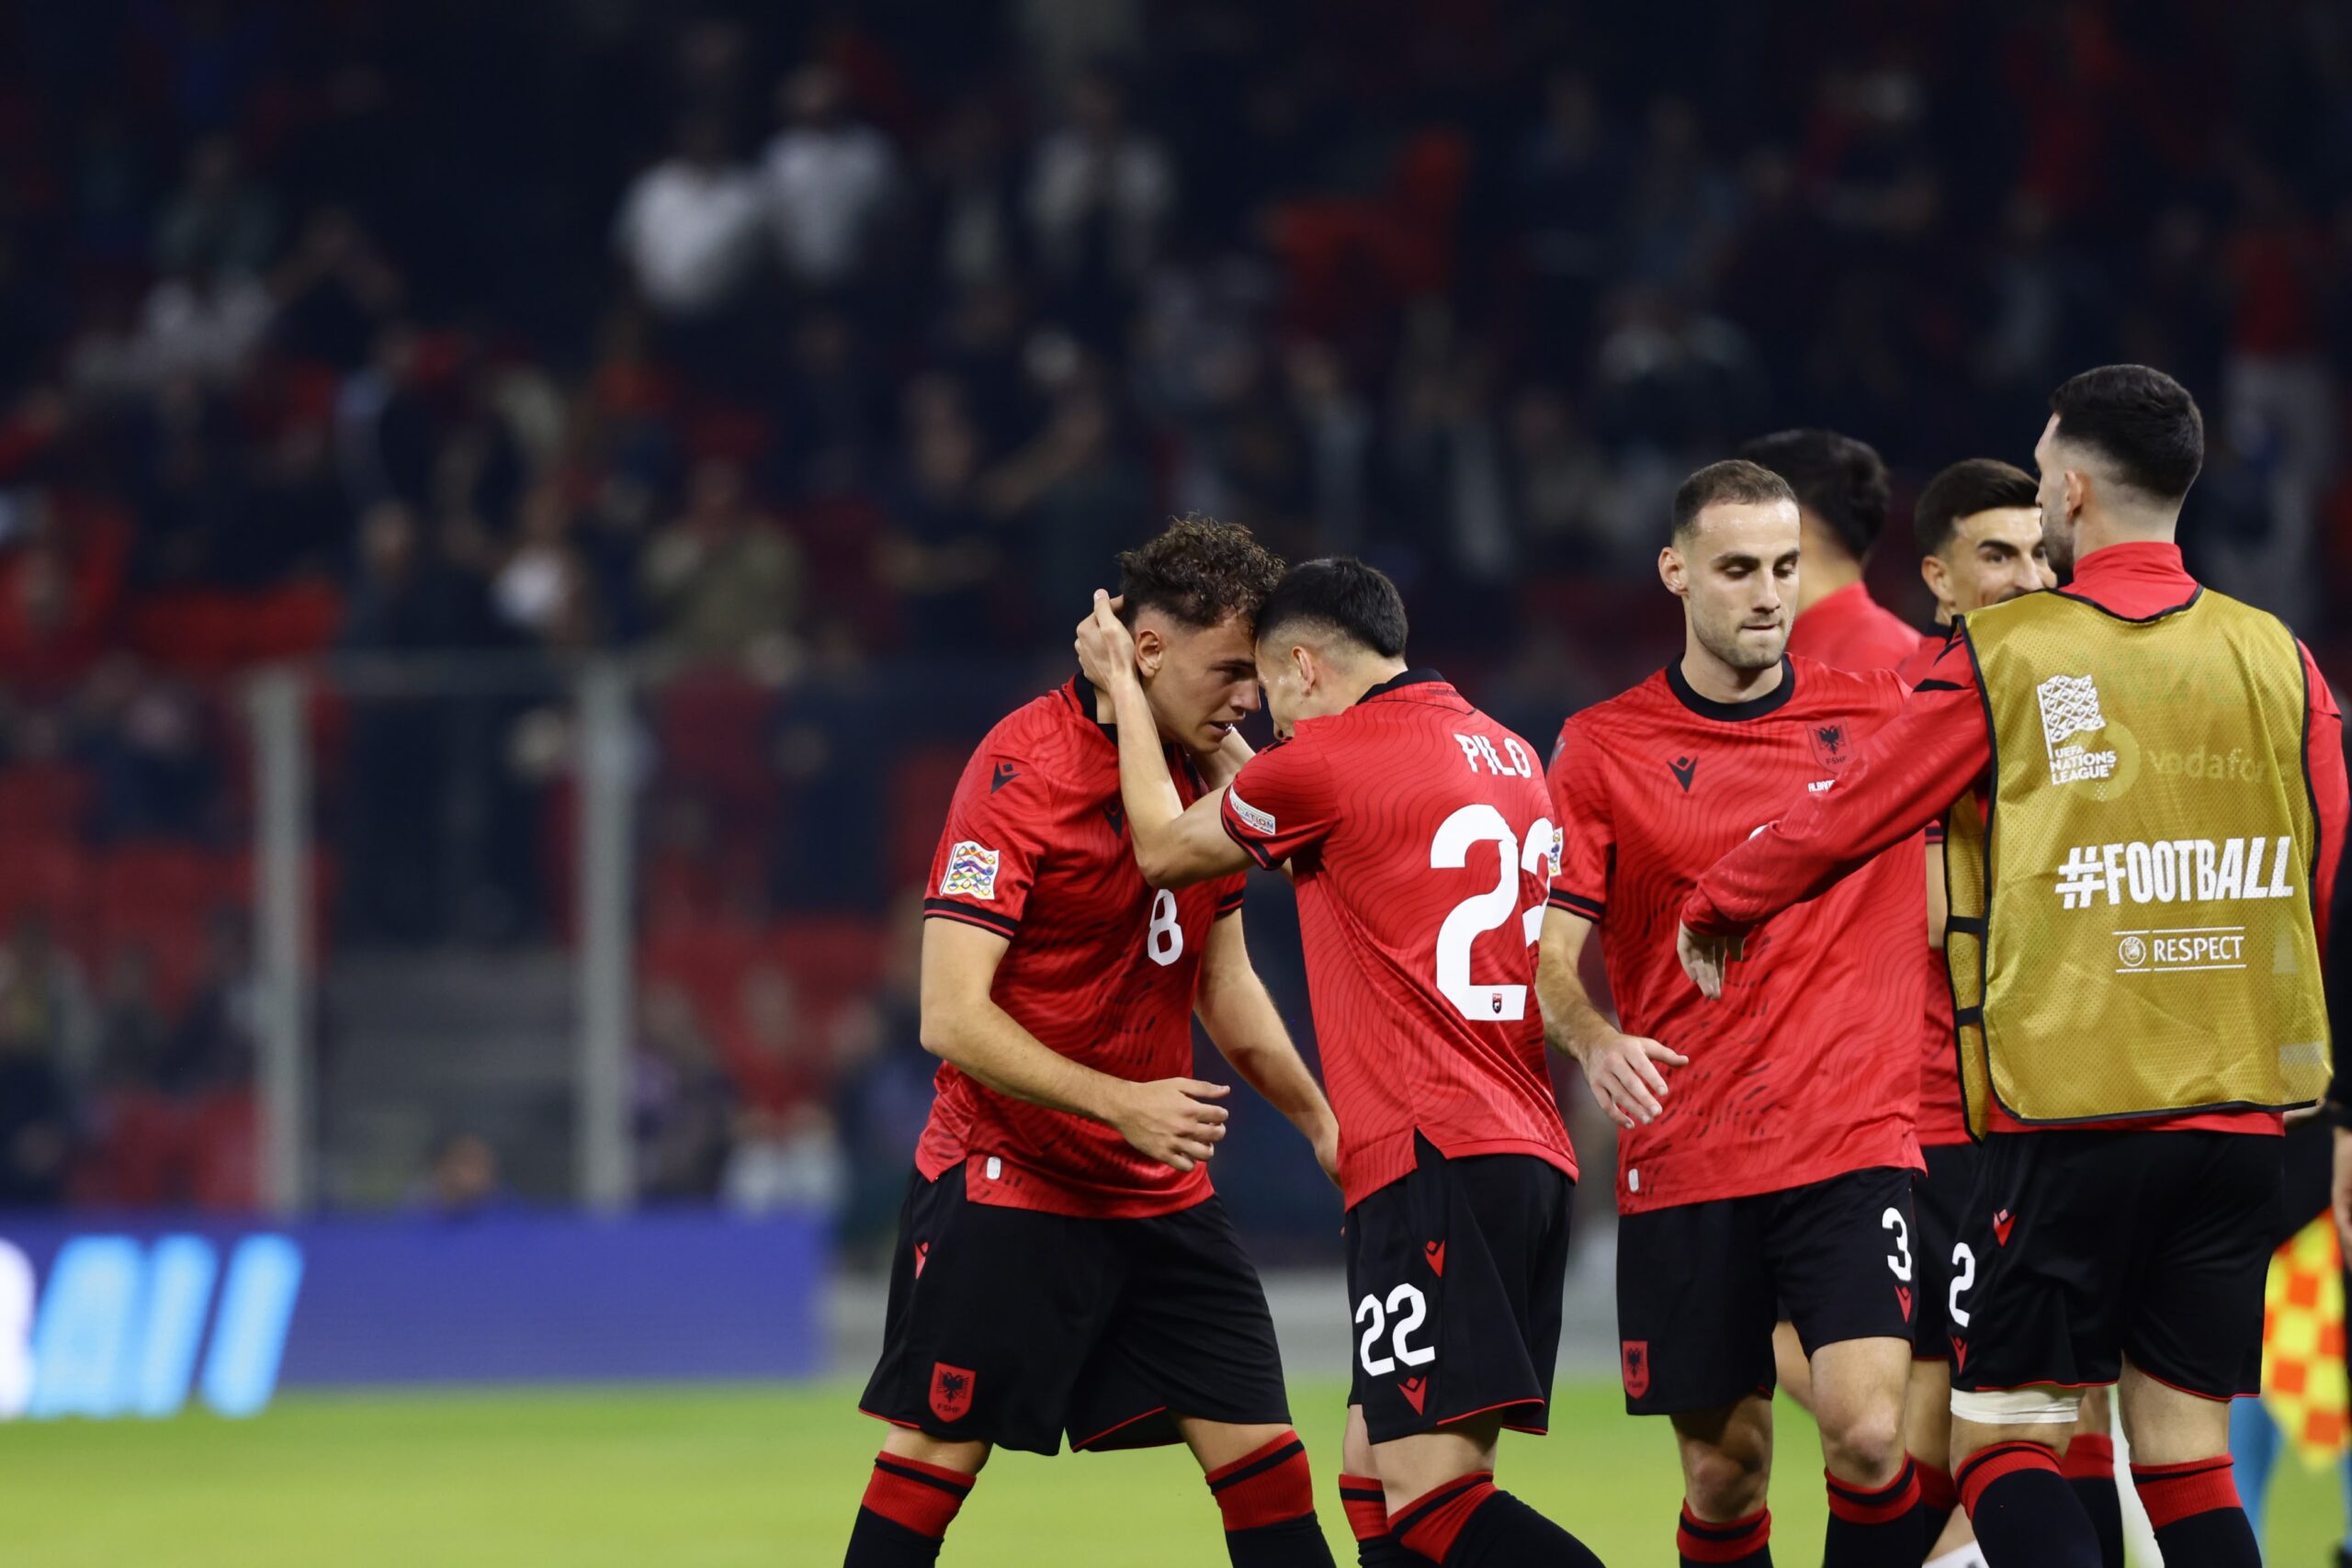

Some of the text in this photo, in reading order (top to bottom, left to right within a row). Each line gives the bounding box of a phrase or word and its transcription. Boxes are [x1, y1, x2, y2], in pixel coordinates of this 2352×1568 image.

[1453, 733, 1532, 779] PILO
[2050, 750, 2117, 773] NATIONS
[2052, 764, 2110, 785] LEAGUE
[2054, 745, 2085, 759] UEFA
[2055, 836, 2294, 909] #FOOTBALL
[1148, 888, 1184, 966] 8
[2154, 935, 2245, 962] RESPECT
[1882, 1207, 1913, 1281] 3
[1949, 1242, 1975, 1327] 2
[1355, 1282, 1436, 1377] 22
